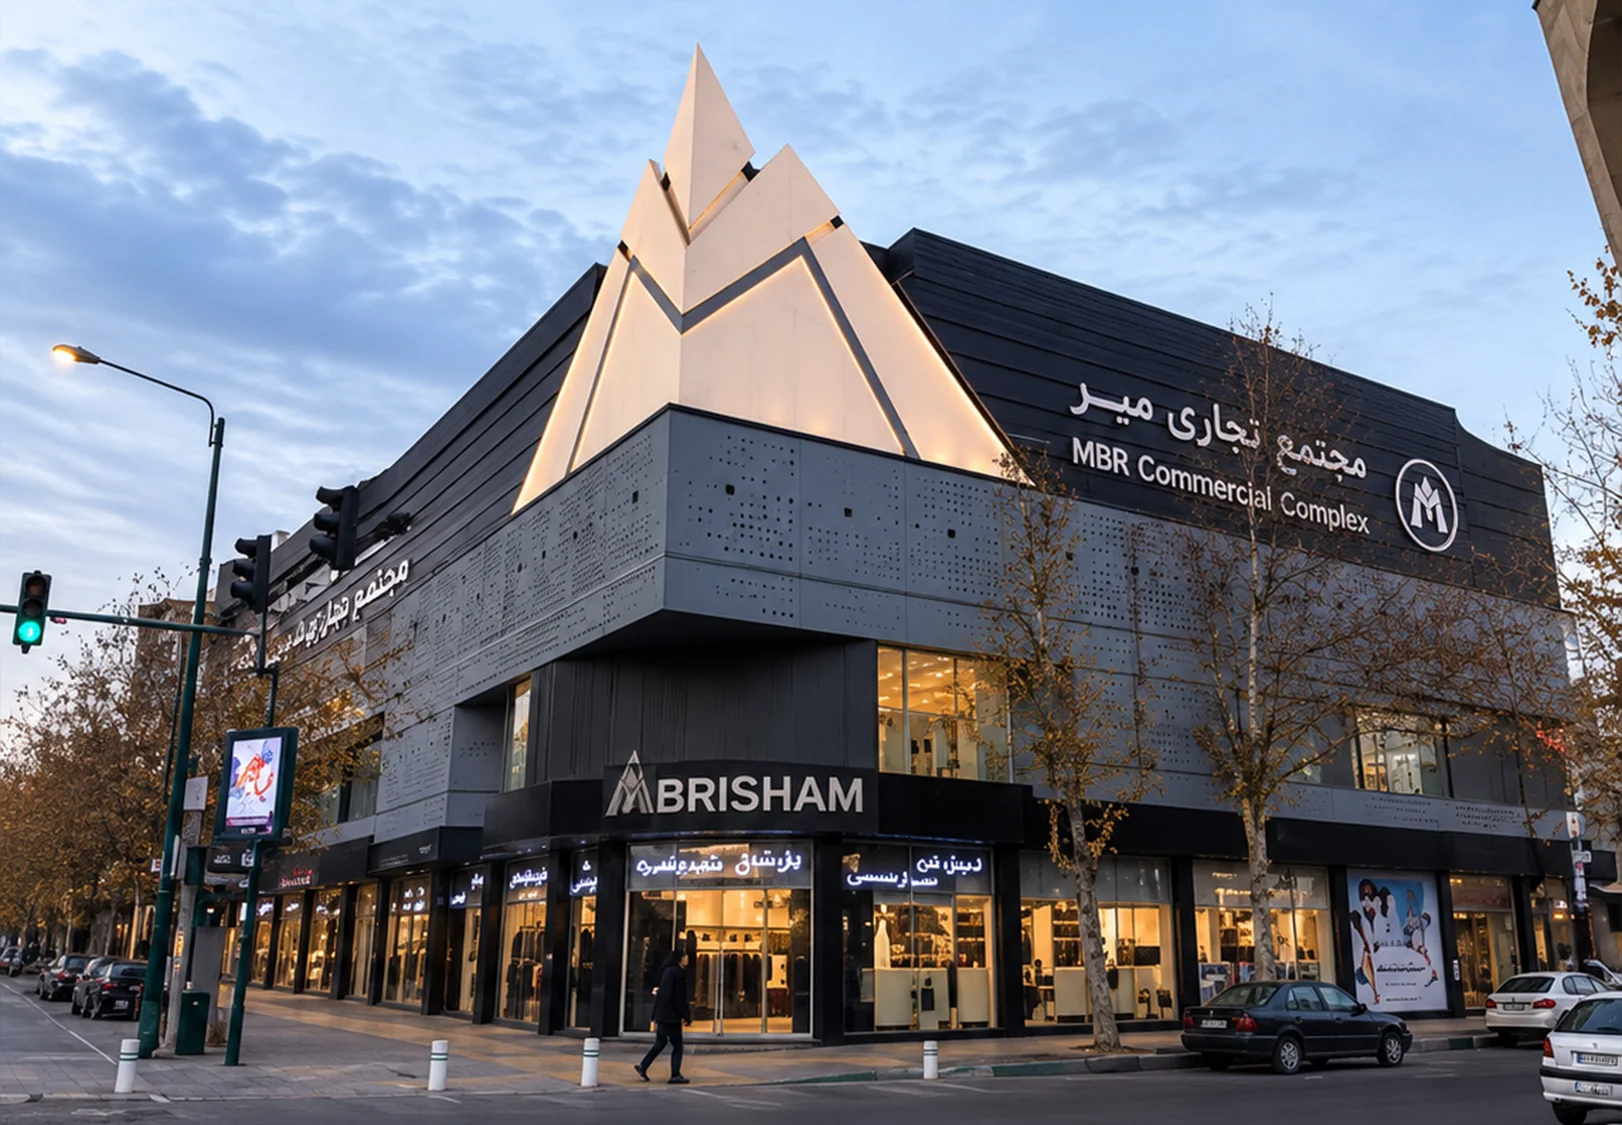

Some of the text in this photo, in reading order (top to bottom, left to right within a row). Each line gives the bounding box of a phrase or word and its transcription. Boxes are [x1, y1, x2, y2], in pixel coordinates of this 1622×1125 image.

[1069, 382, 1367, 482] مجتمع تجاری میر
[1071, 437, 1370, 535] MBR Commercial Complex
